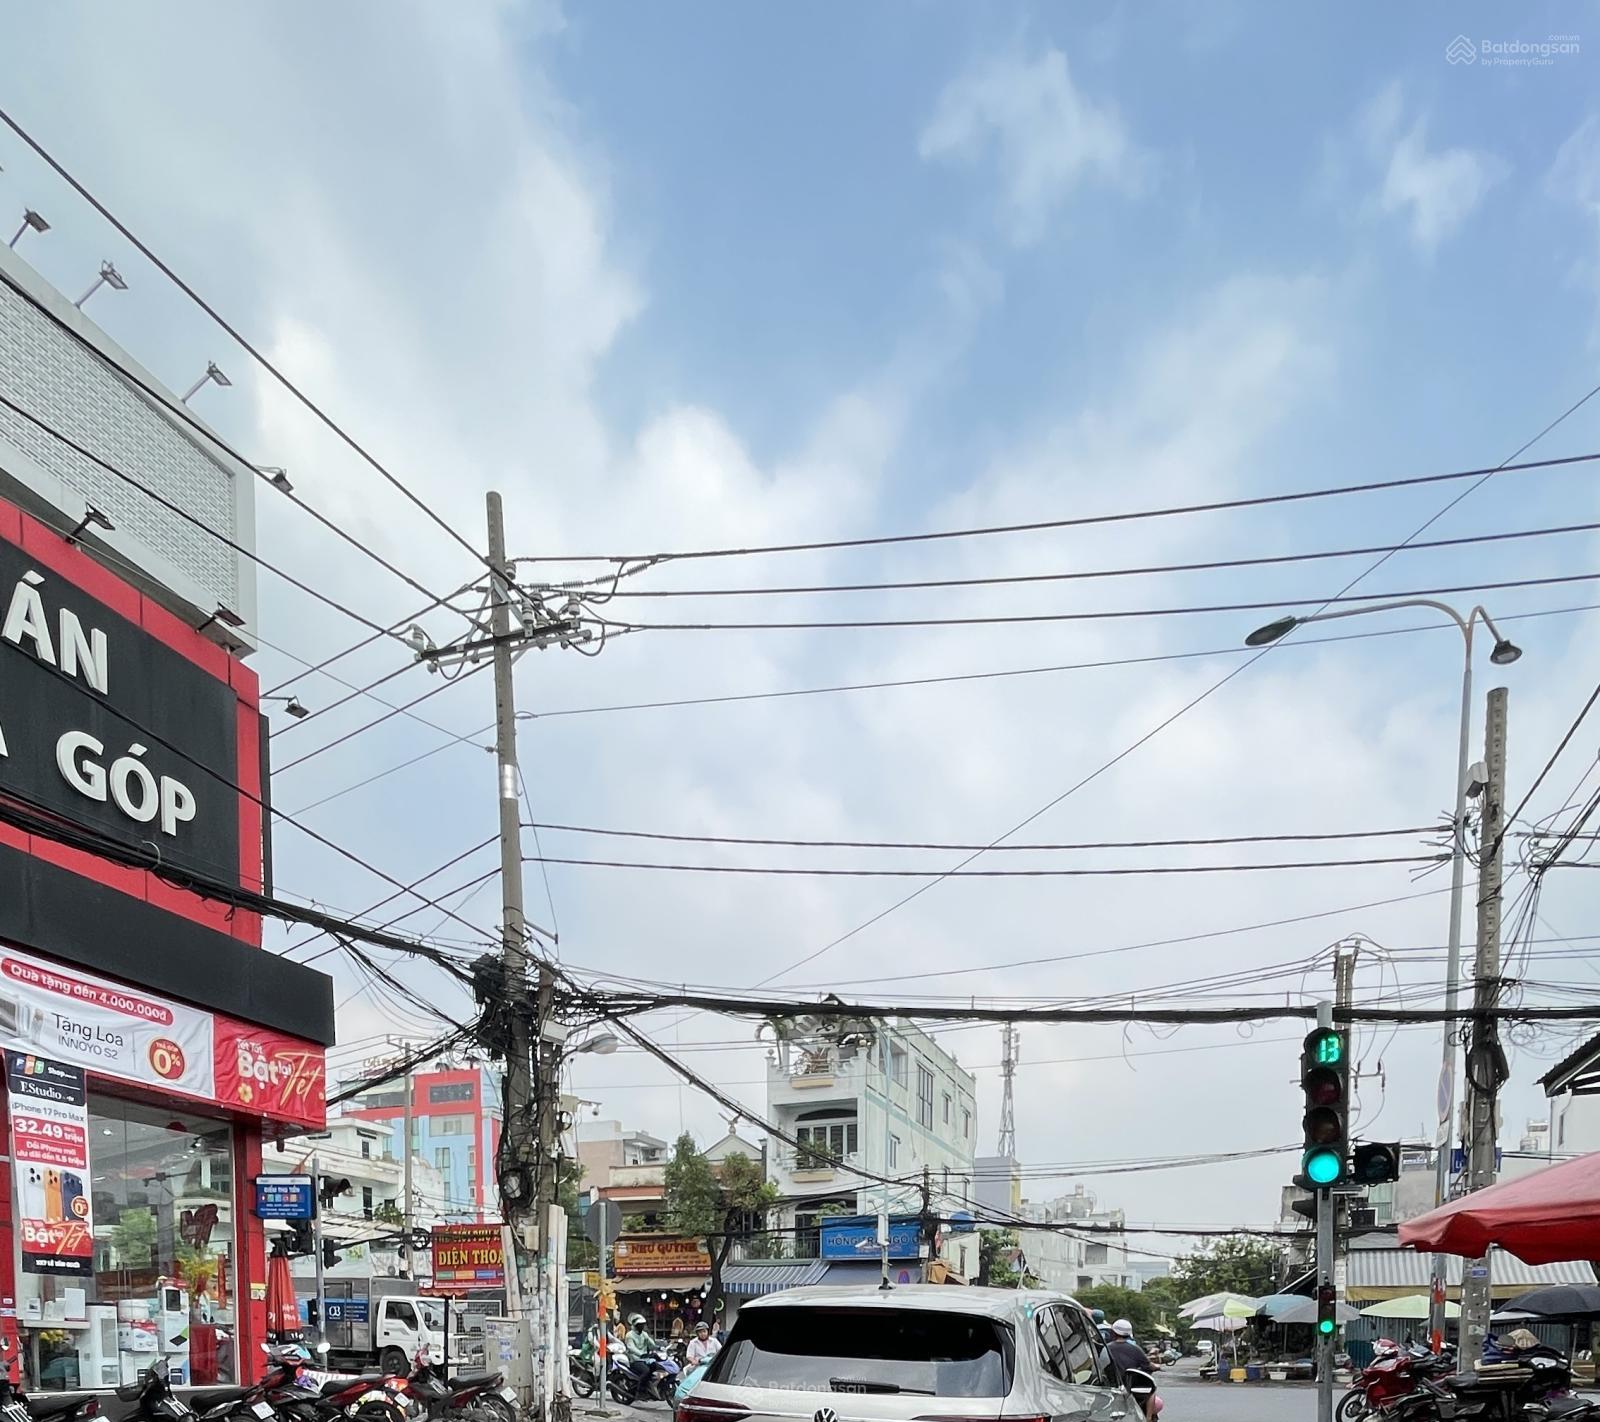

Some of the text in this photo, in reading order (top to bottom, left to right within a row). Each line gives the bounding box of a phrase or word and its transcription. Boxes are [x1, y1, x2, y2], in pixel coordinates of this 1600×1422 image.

[56, 731, 197, 836] GÓP
[99, 992, 167, 1021] 4.000.000đ
[51, 1012, 124, 1047] Tặng Loa
[58, 1035, 119, 1060] INNOYO S2
[1320, 1037, 1339, 1062] 13
[237, 1050, 279, 1089] Bật
[20, 1081, 62, 1100] F.Studio
[12, 1102, 84, 1122] iPhone 17 Pro Max
[15, 1118, 63, 1139] 32.49
[25, 1226, 56, 1248] Bật
[472, 1249, 505, 1267] THOẠ
